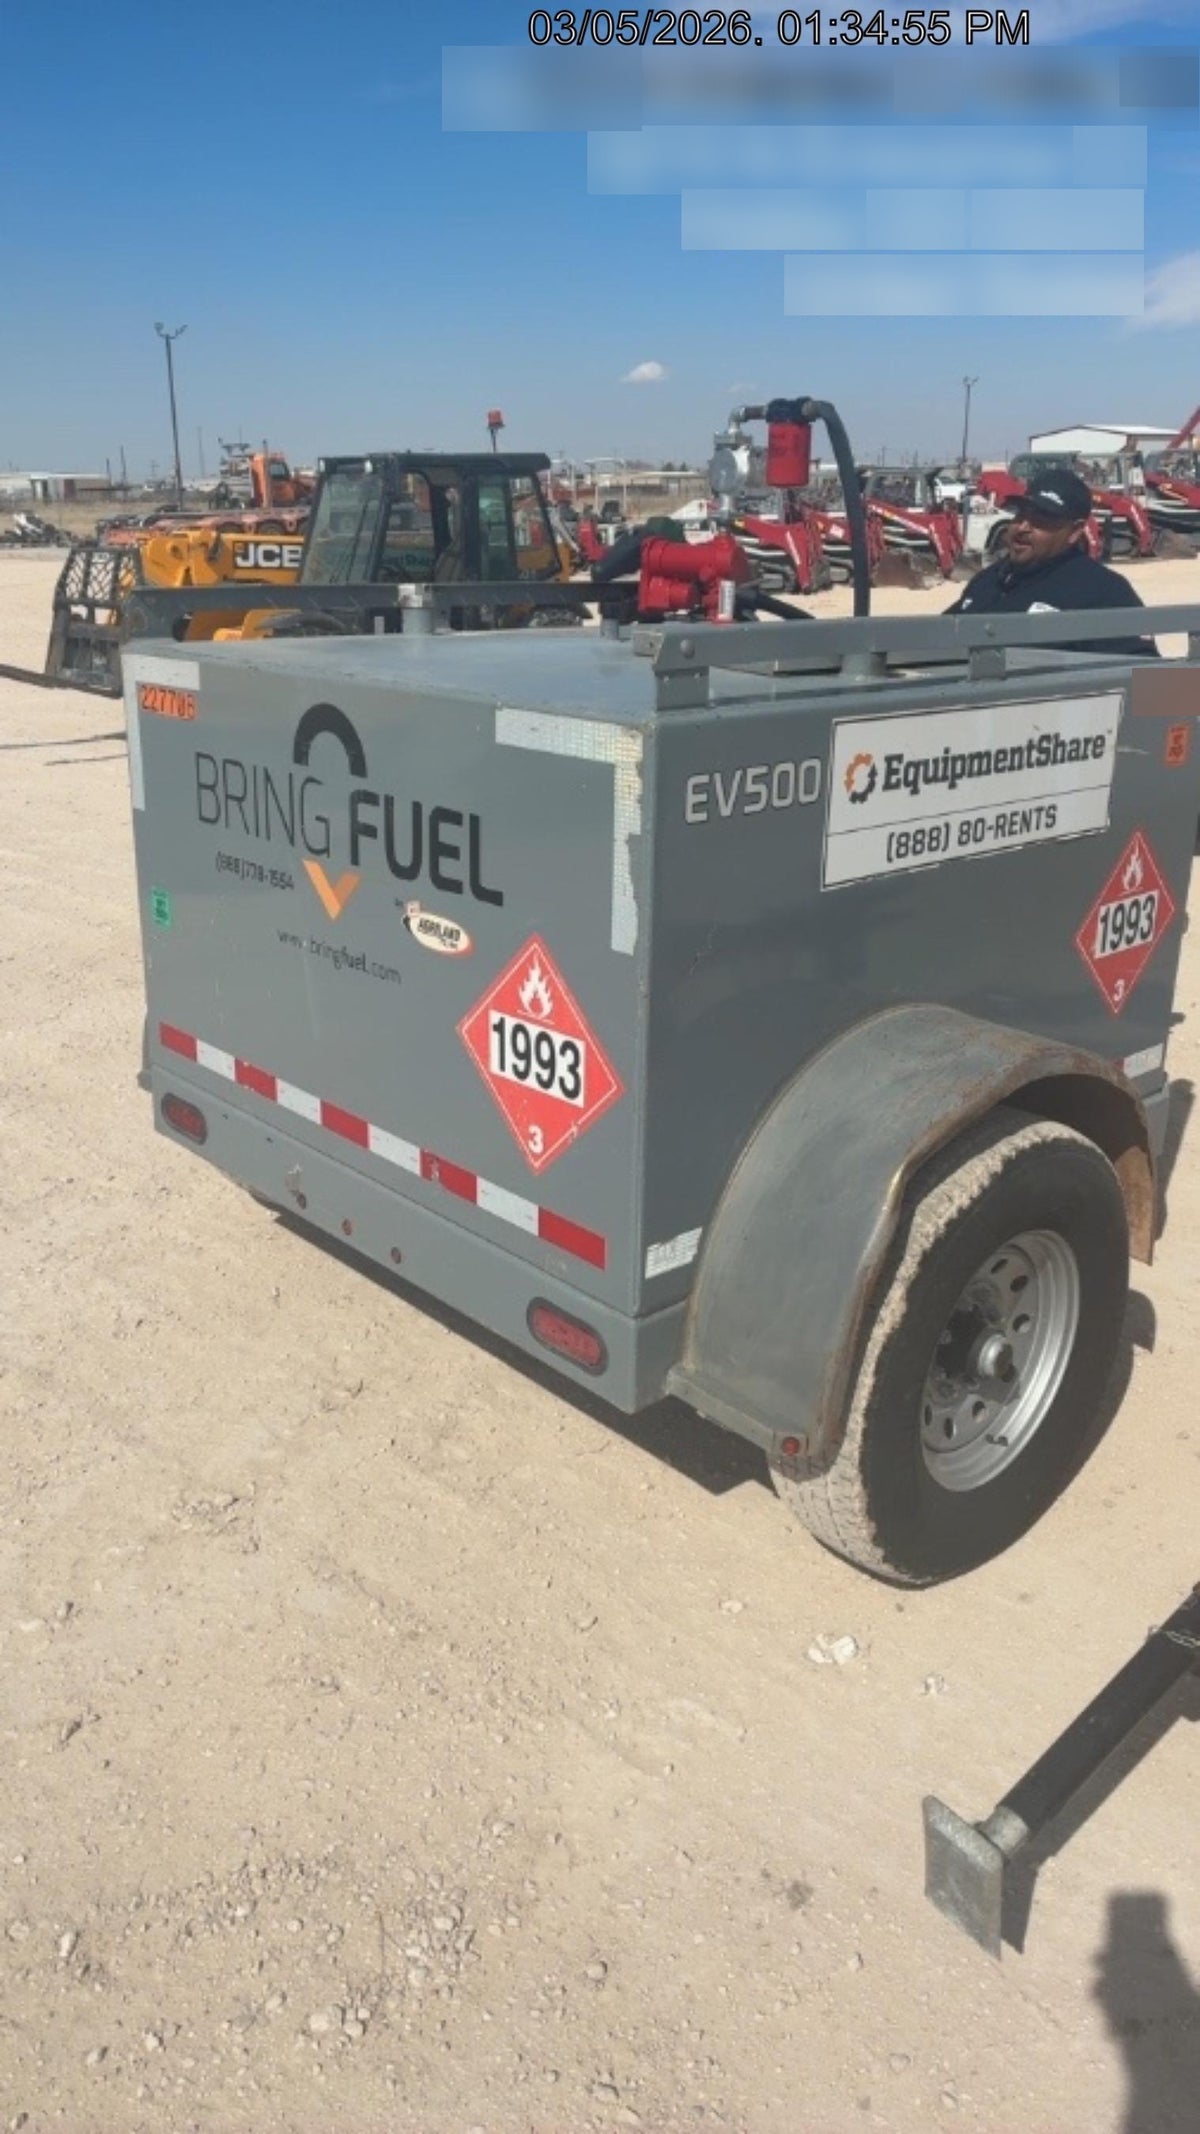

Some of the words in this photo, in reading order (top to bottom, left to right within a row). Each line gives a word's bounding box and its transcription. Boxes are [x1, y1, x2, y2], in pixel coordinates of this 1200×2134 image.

[684, 758, 821, 824] EV500
[882, 733, 1105, 797] EquipmentShare
[195, 752, 331, 858] BRING
[350, 789, 504, 907] FUEL
[886, 822, 949, 863] (888)
[957, 804, 1057, 851] 80-RENTS
[1100, 894, 1156, 954] 1993
[1114, 978, 1125, 1002] 3
[492, 1016, 581, 1100] 1993
[528, 1125, 544, 1153] 3
